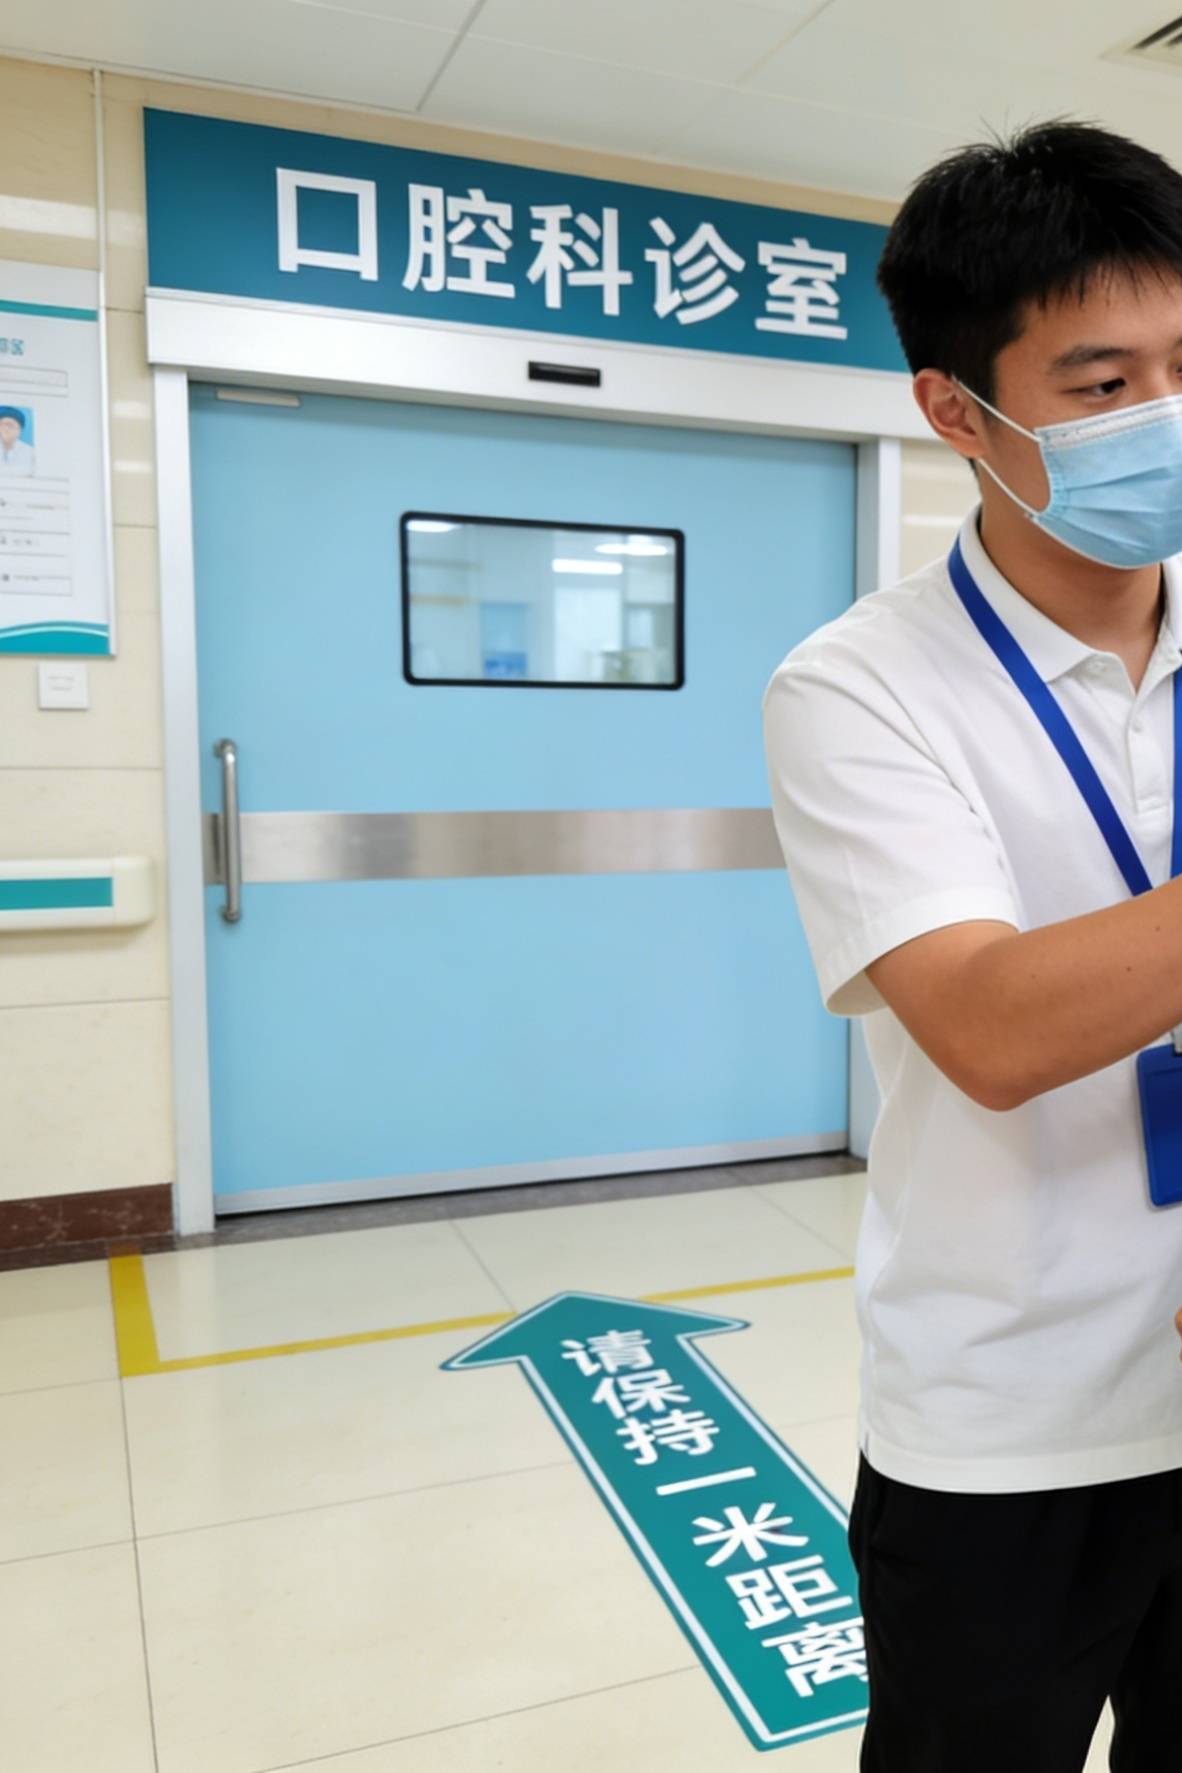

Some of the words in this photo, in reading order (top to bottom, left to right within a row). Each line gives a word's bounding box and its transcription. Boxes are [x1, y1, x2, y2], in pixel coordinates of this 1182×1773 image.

[275, 166, 848, 340] 口腔科诊室
[560, 1329, 869, 1698] 请保持一米距离
